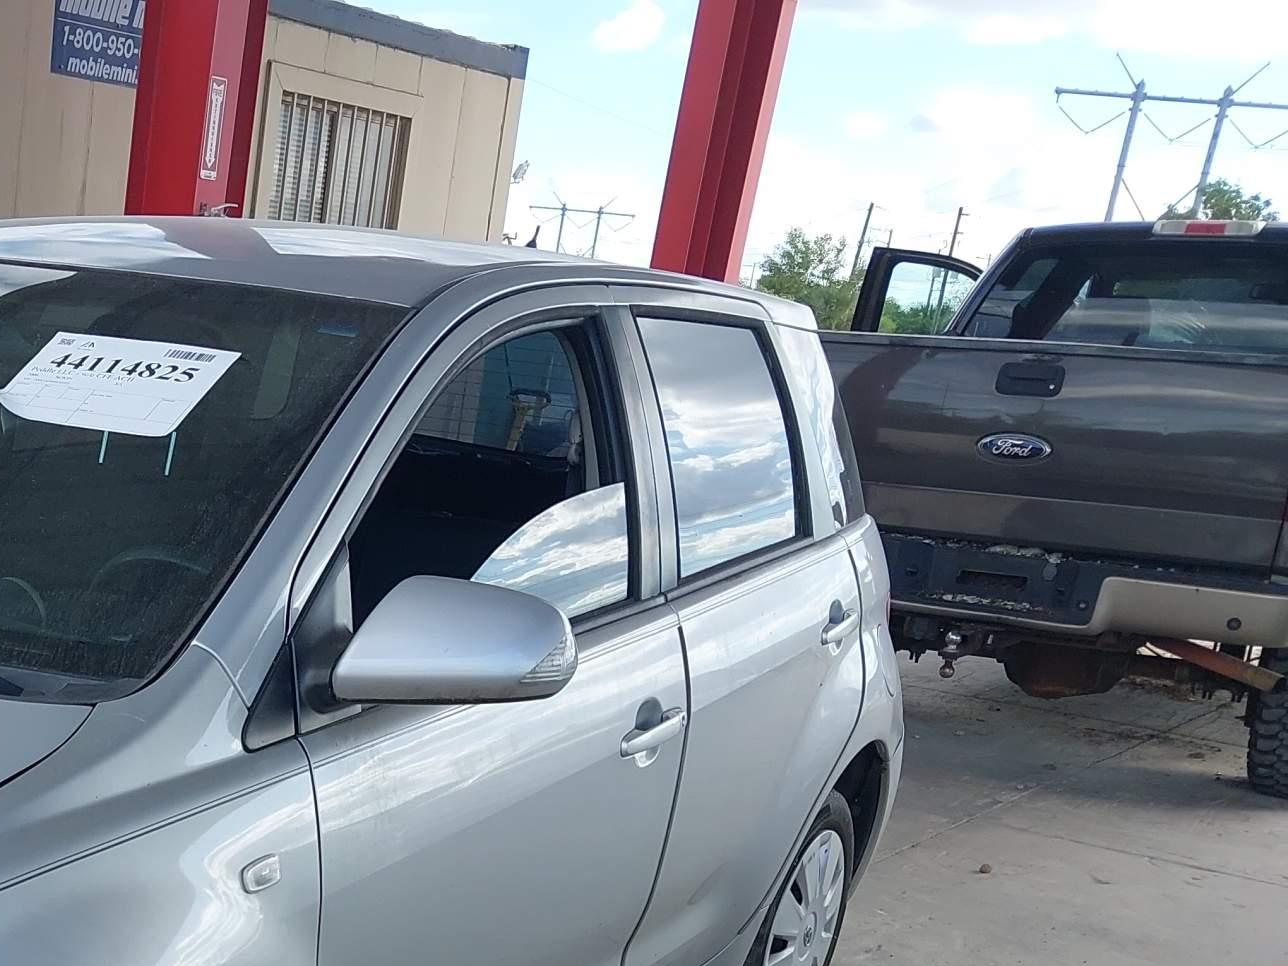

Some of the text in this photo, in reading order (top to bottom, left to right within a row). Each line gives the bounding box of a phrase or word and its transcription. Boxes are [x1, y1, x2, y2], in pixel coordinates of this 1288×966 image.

[62, 25, 141, 58] 1-800-950-
[50, 352, 201, 383] 44114825
[992, 439, 1033, 456] Ford
